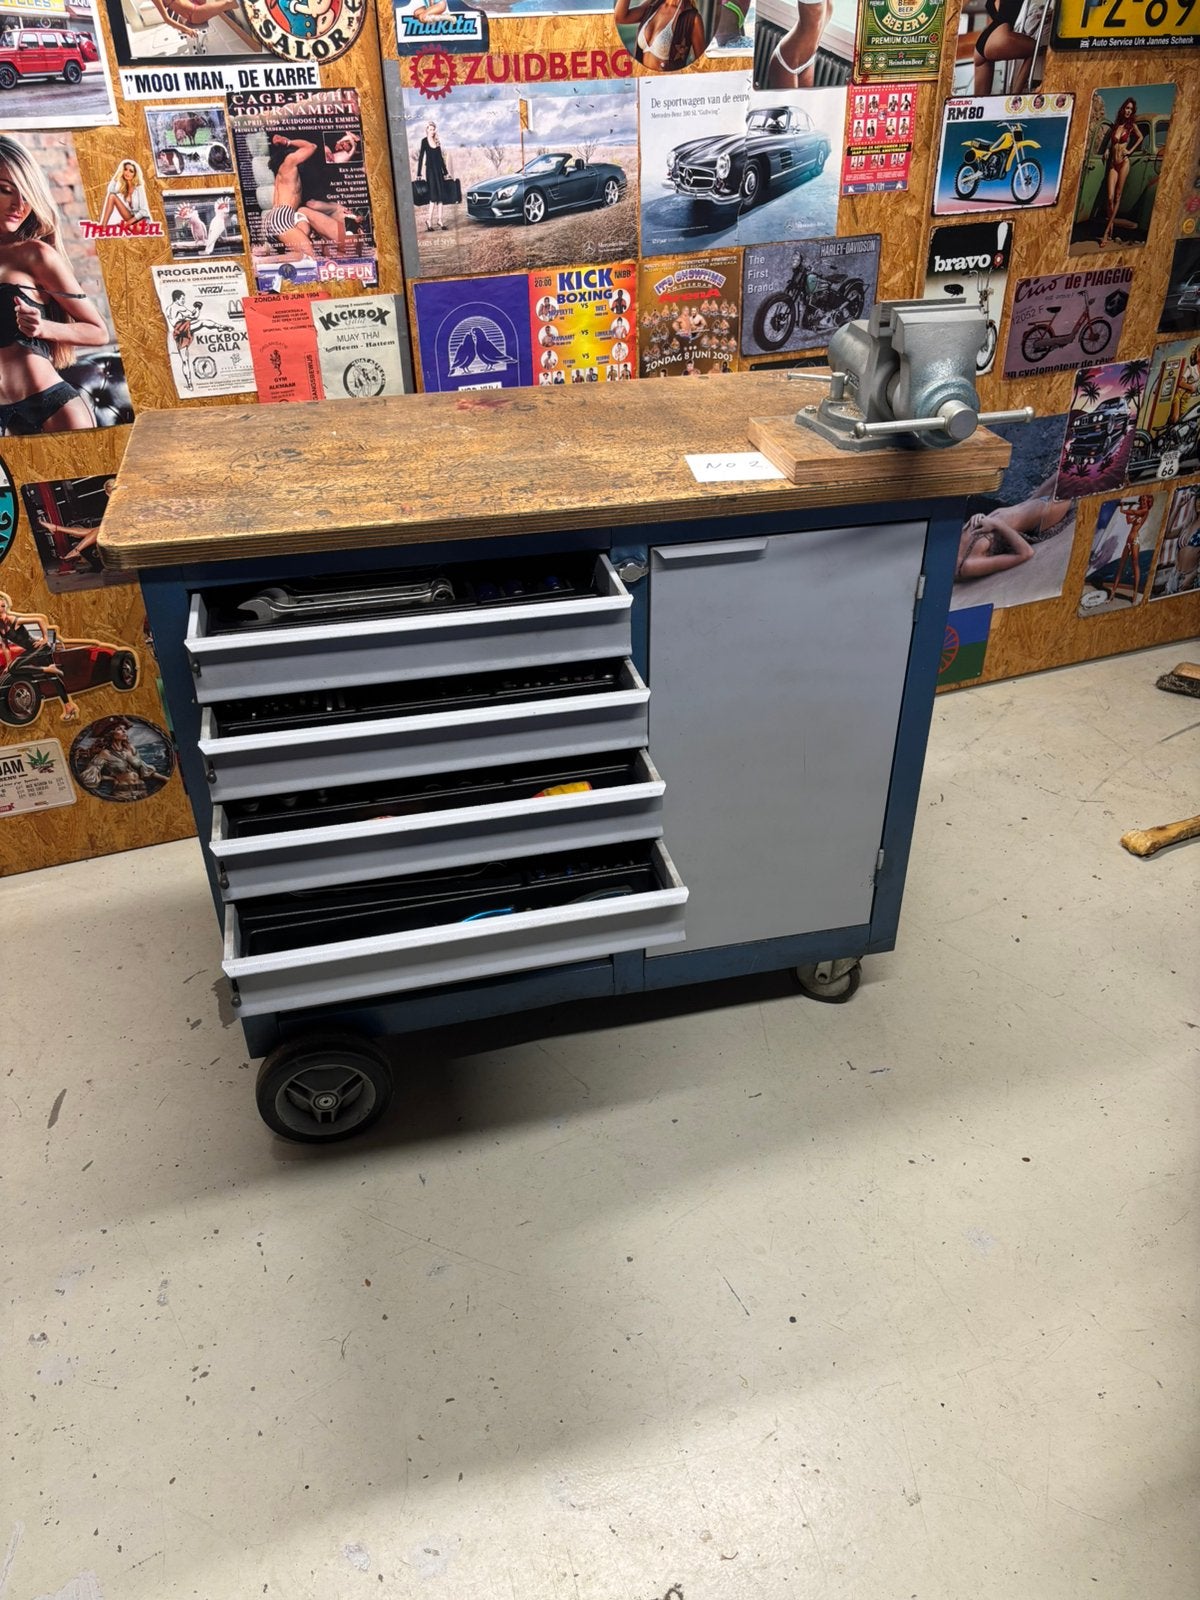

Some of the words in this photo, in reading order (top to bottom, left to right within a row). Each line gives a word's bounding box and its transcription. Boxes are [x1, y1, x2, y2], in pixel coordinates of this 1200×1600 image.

[871, 36, 902, 44] PREMIUM
[902, 36, 928, 44] QUALITY
[1092, 38, 1107, 47] Auto
[1109, 38, 1132, 46] Service
[1134, 38, 1145, 46] Urk
[1146, 37, 1169, 45] Jannes
[1170, 36, 1194, 44] Schenk
[463, 49, 633, 84] ZUIDBERG
[238, 69, 259, 88] DE
[264, 66, 317, 87] KARRE
[232, 88, 354, 105] CAGE-FIGHT
[651, 98, 661, 108] De
[663, 98, 706, 110] sportwagen
[708, 96, 720, 104] van
[722, 94, 731, 104] de
[234, 103, 355, 117] TOURNAMENT
[820, 240, 876, 257] HARLEY-DAVIDSON
[748, 256, 765, 264] The
[157, 266, 242, 278] PROGRAMMA
[747, 269, 768, 280] First
[534, 278, 552, 288] 20:00
[557, 268, 614, 292] KICK
[1015, 275, 1064, 304] Ciao
[1065, 274, 1081, 290] de
[1083, 268, 1134, 288] PIAGGIO
[667, 283, 712, 292] AMSTERDAM
[747, 283, 774, 294] Brand
[557, 289, 613, 305] BOXING
[196, 332, 248, 345] KICKBOX
[336, 333, 359, 342] MUAY
[361, 331, 380, 340] THAI
[208, 342, 240, 353] GALA
[366, 340, 395, 348] Hattem
[645, 354, 683, 372] ZONDAG
[684, 352, 690, 360] 8
[691, 350, 710, 360] JUNI
[712, 351, 733, 362] 2003
[1018, 362, 1078, 377] cyclomoteur
[1161, 466, 1174, 477] 66
